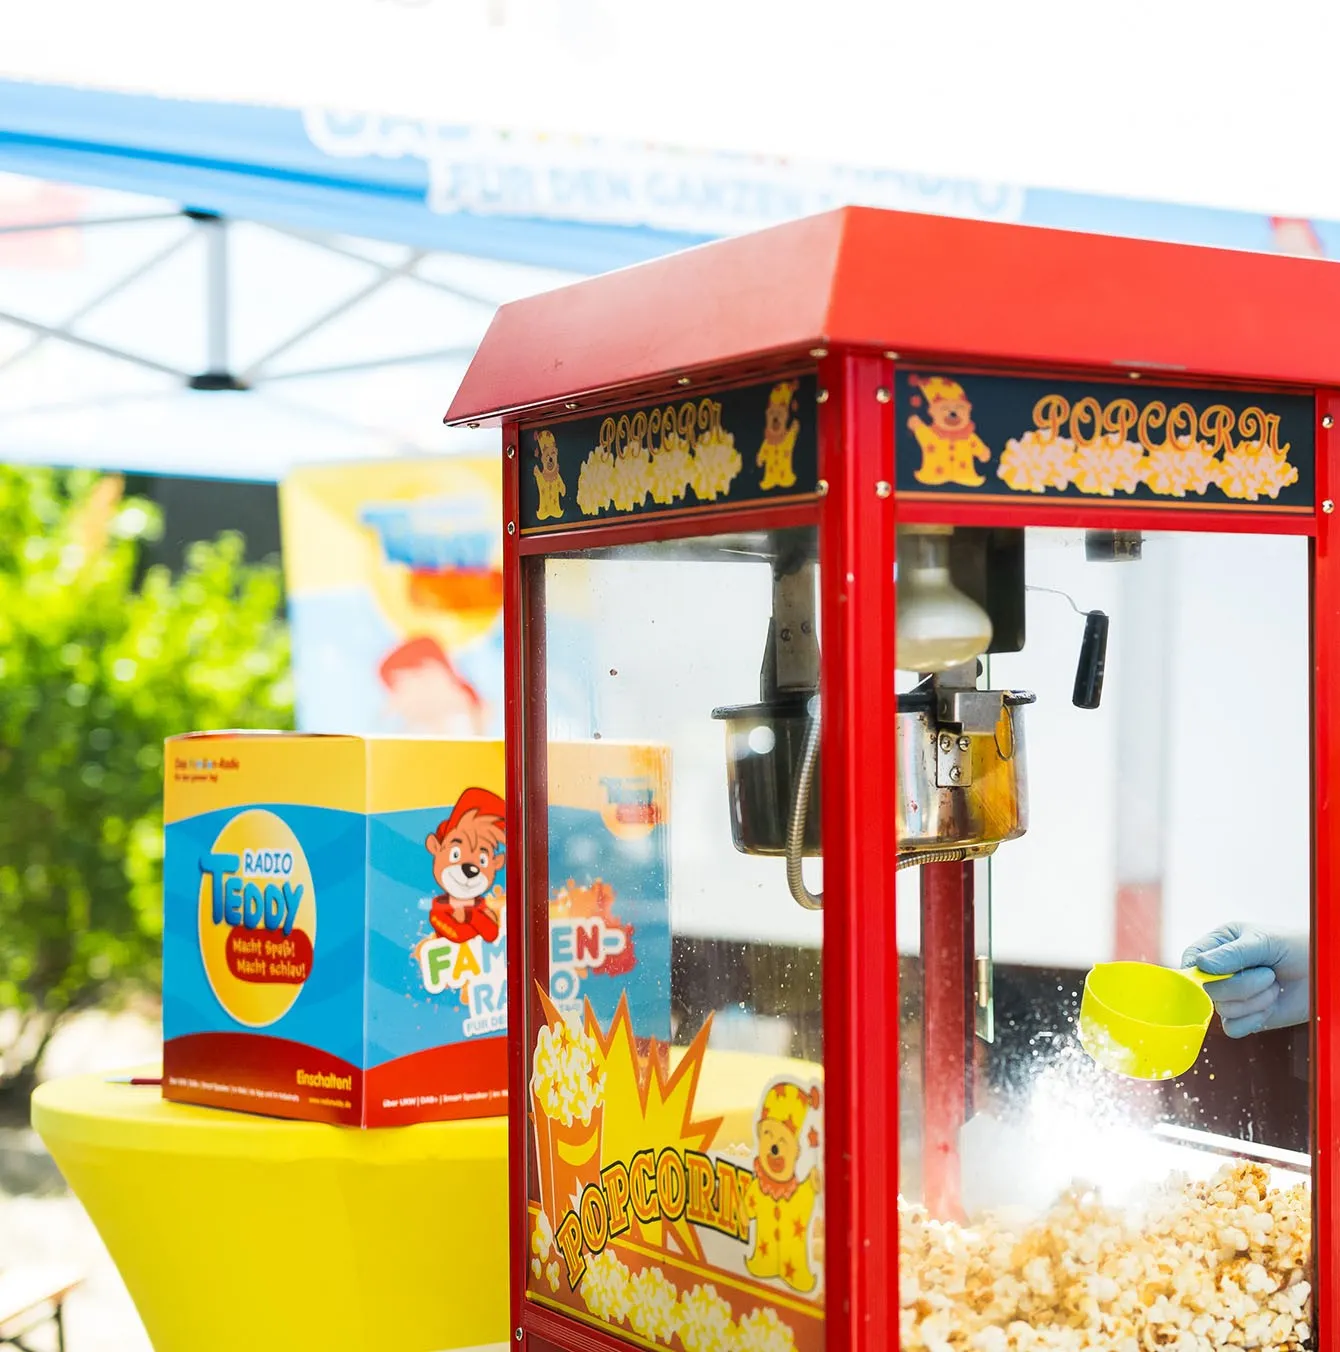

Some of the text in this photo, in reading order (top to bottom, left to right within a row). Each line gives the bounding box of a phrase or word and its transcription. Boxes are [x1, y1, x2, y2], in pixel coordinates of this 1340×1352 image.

[599, 397, 723, 462] POPCORN
[1031, 394, 1289, 456] POPCORN
[244, 852, 293, 875] RADIO
[198, 853, 304, 937] TEDDY
[232, 937, 262, 957] Macht
[236, 958, 266, 977] Macht
[296, 1069, 352, 1091] Einschalten!
[555, 1146, 756, 1292] POPCORN
